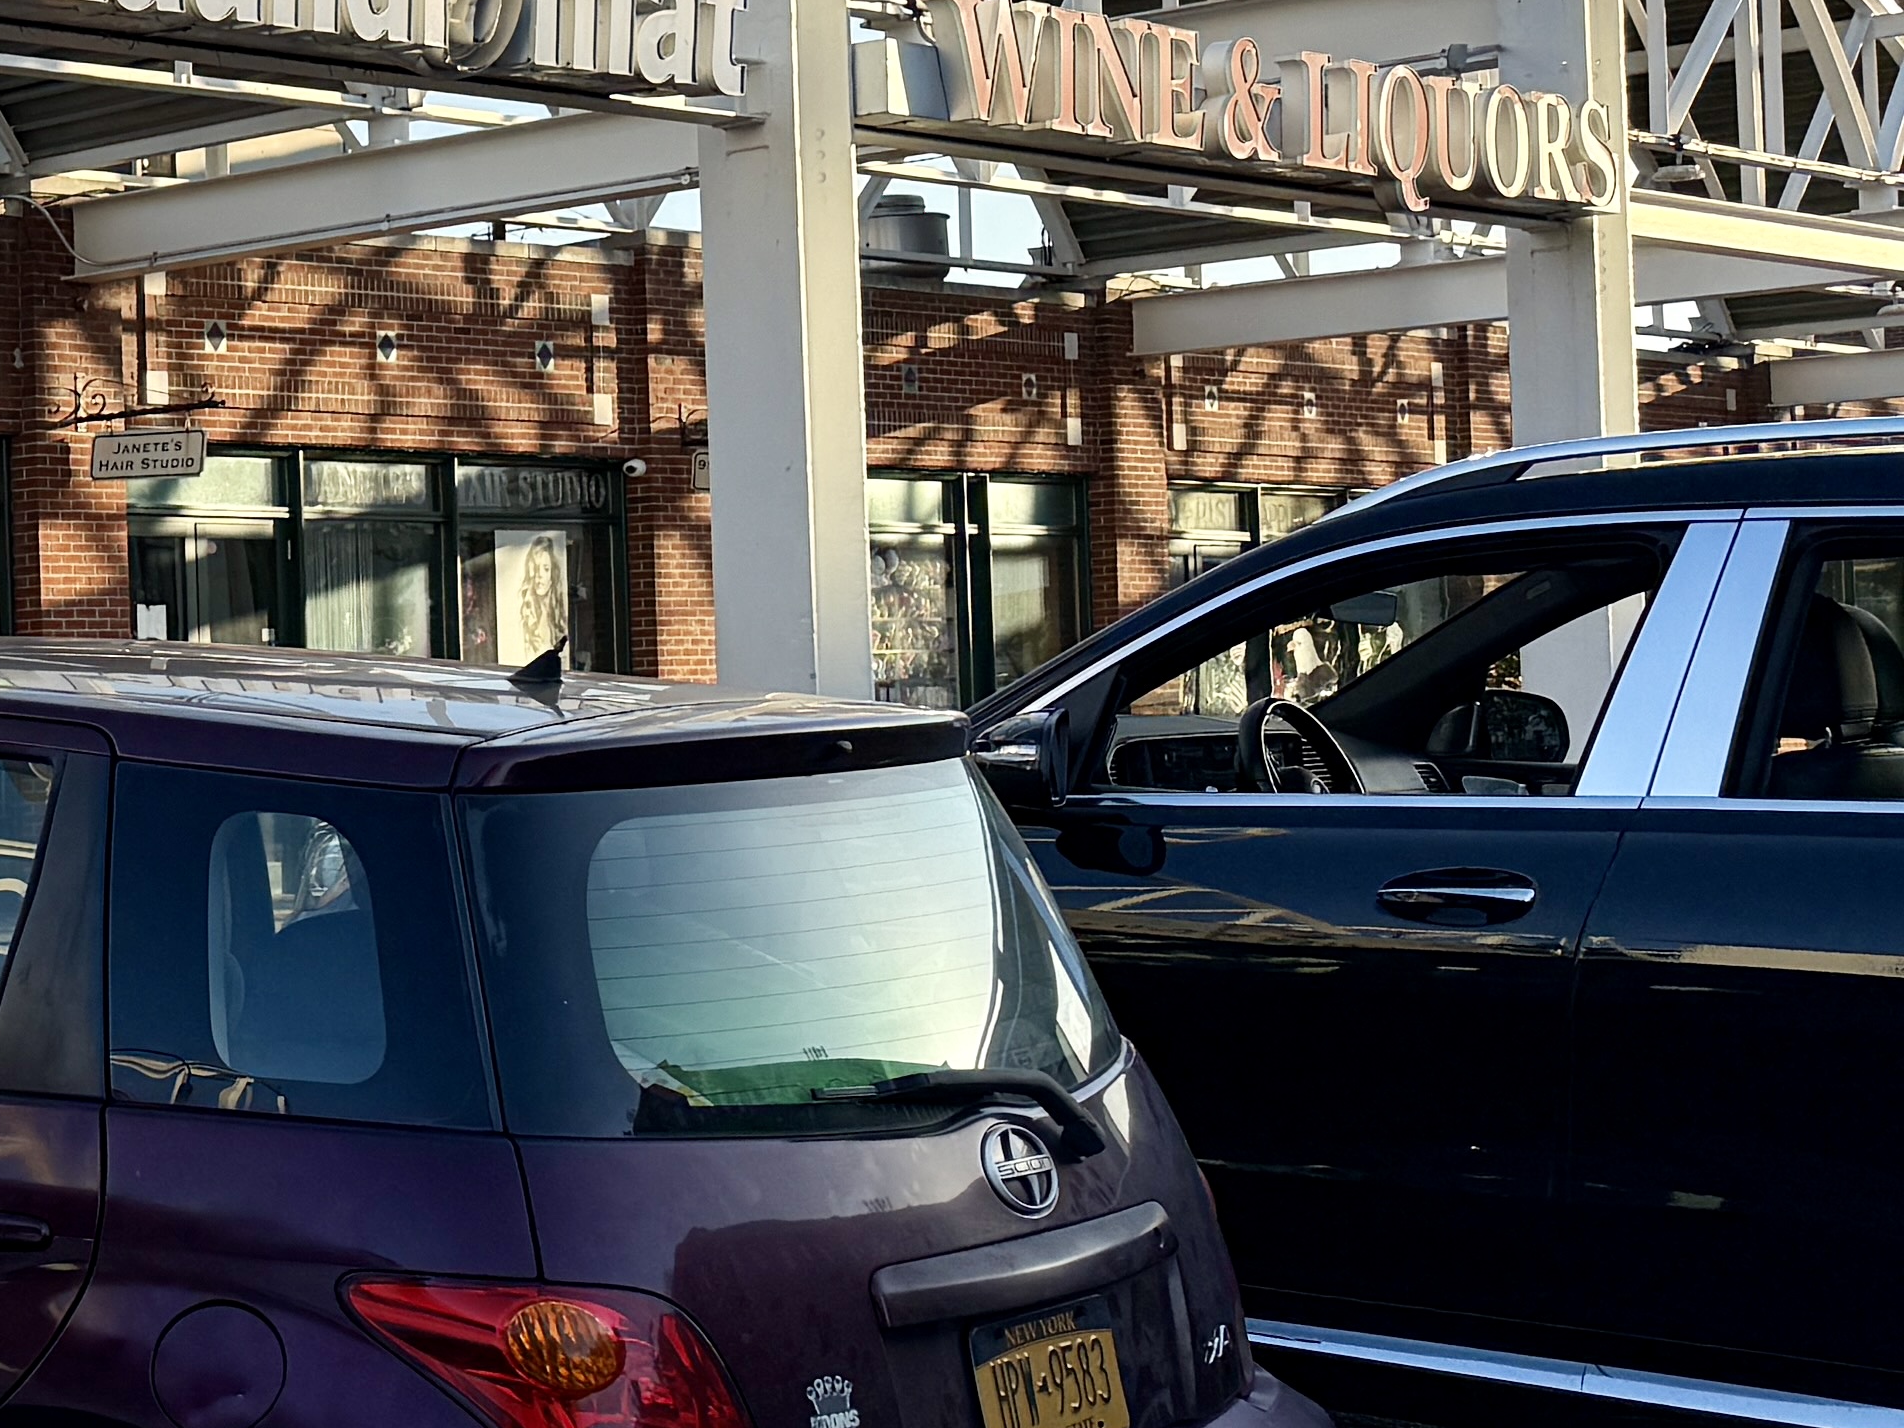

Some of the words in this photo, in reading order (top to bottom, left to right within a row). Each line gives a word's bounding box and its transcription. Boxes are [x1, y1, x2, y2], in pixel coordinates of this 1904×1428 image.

[1214, 36, 1284, 164] &
[1295, 51, 1618, 213] LIQUORS
[110, 438, 184, 457] JANETE'S
[97, 458, 137, 473] HAIR
[140, 455, 196, 472] STUDIO
[1004, 1321, 1038, 1348] NEW
[1039, 1311, 1077, 1338] YORK
